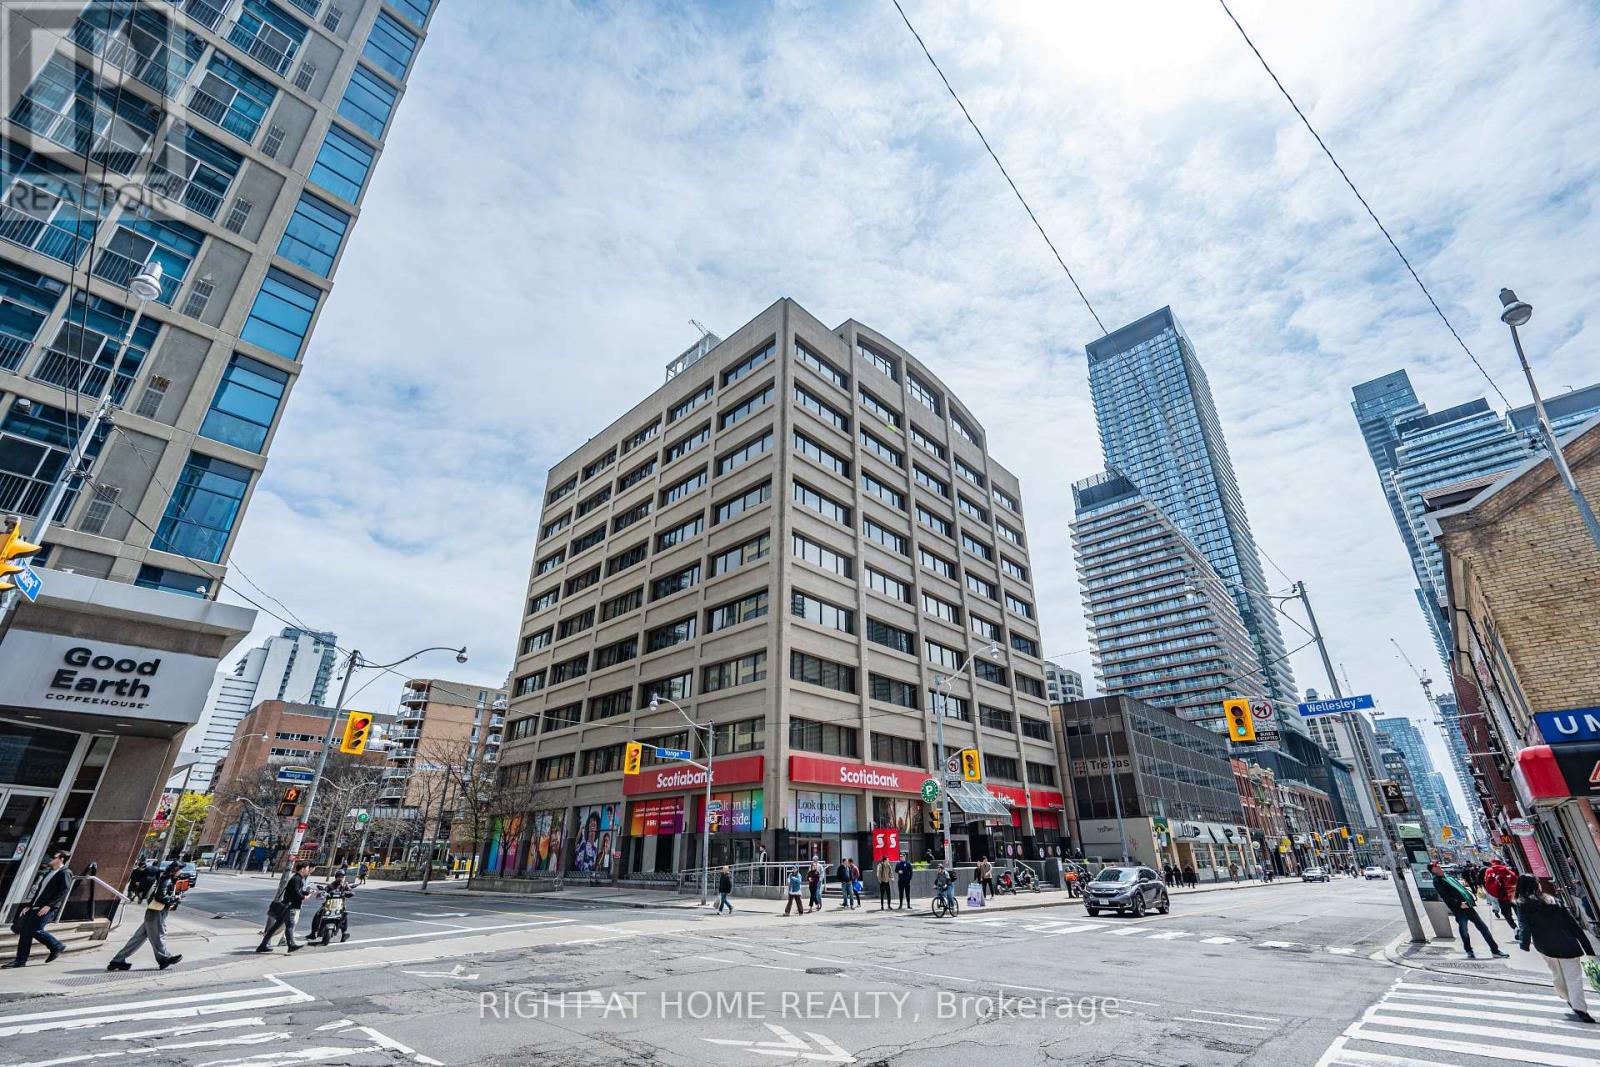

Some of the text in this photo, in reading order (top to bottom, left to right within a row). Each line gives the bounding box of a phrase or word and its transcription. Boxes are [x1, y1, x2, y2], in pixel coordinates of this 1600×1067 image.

[64, 646, 161, 676] Good
[50, 668, 151, 698] Earth
[45, 693, 147, 709] COFFEEHOUSE
[1306, 700, 1356, 713] Wellesley
[665, 749, 680, 759] Yonge
[840, 766, 899, 788] Scotiabank
[797, 799, 816, 810] Look
[827, 801, 840, 811] the
[799, 812, 839, 825] Pride side.
